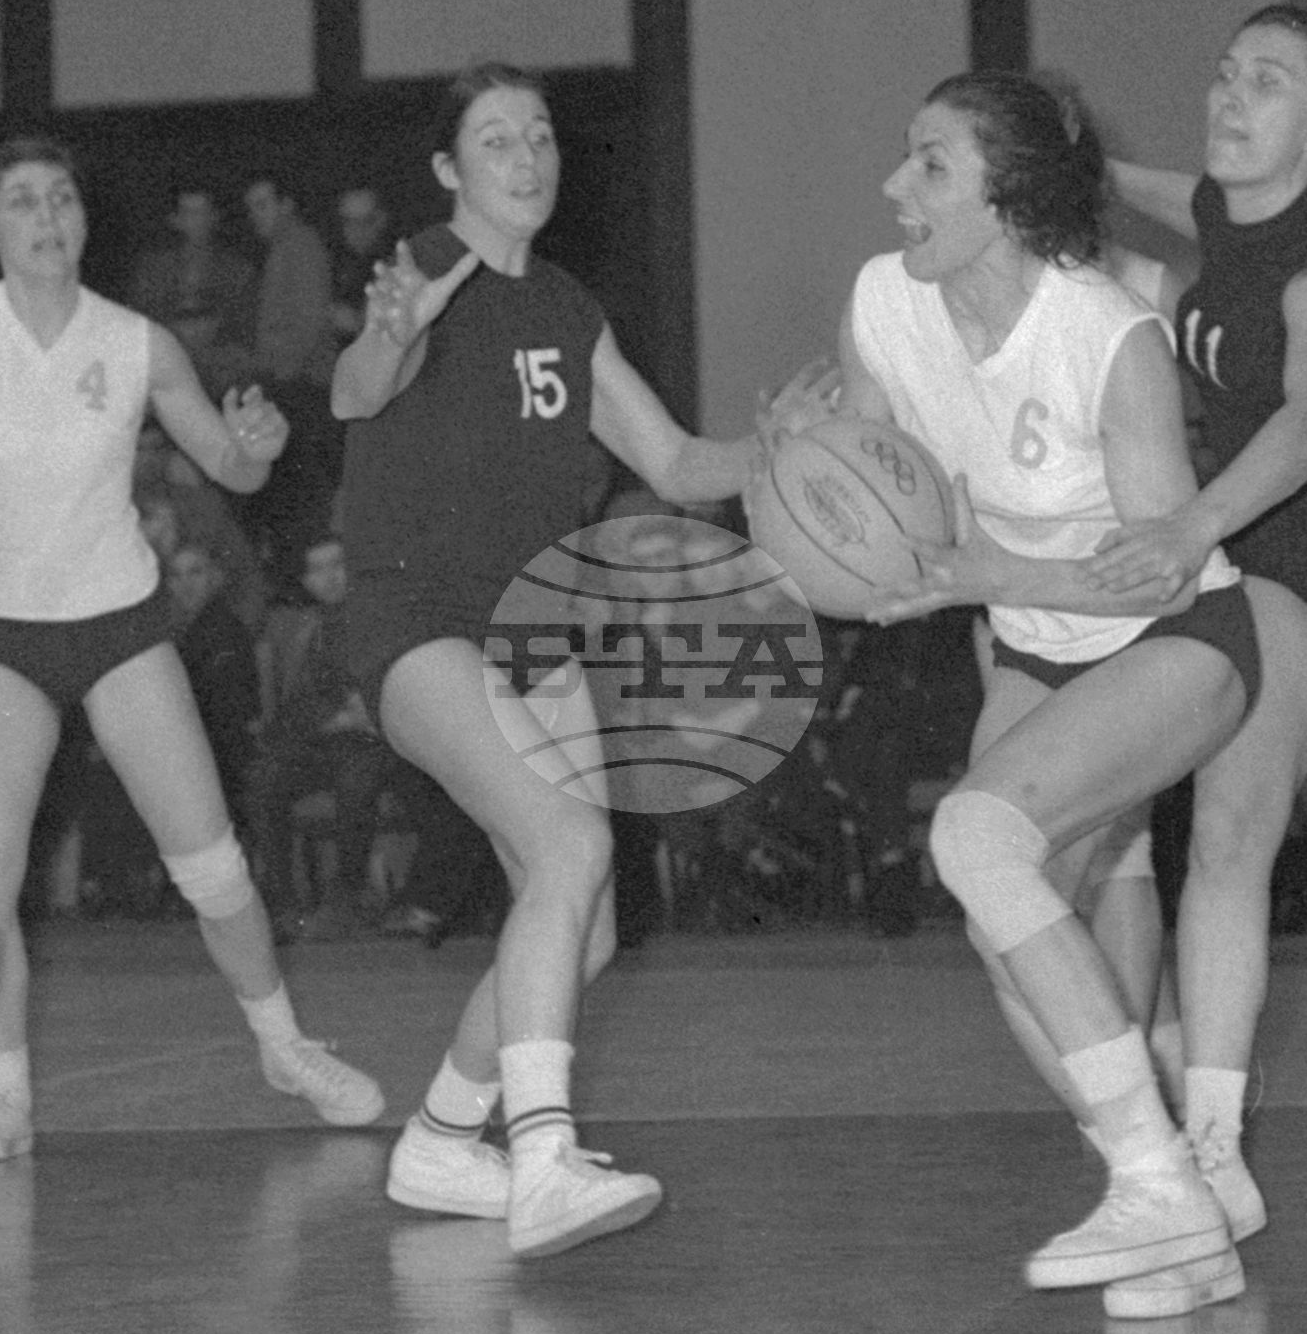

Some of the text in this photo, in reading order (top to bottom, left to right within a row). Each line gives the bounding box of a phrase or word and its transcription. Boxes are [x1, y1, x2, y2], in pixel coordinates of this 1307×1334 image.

[76, 359, 108, 411] 4
[514, 348, 567, 419] 15
[1185, 308, 1230, 391] 11
[1011, 397, 1049, 469] 6
